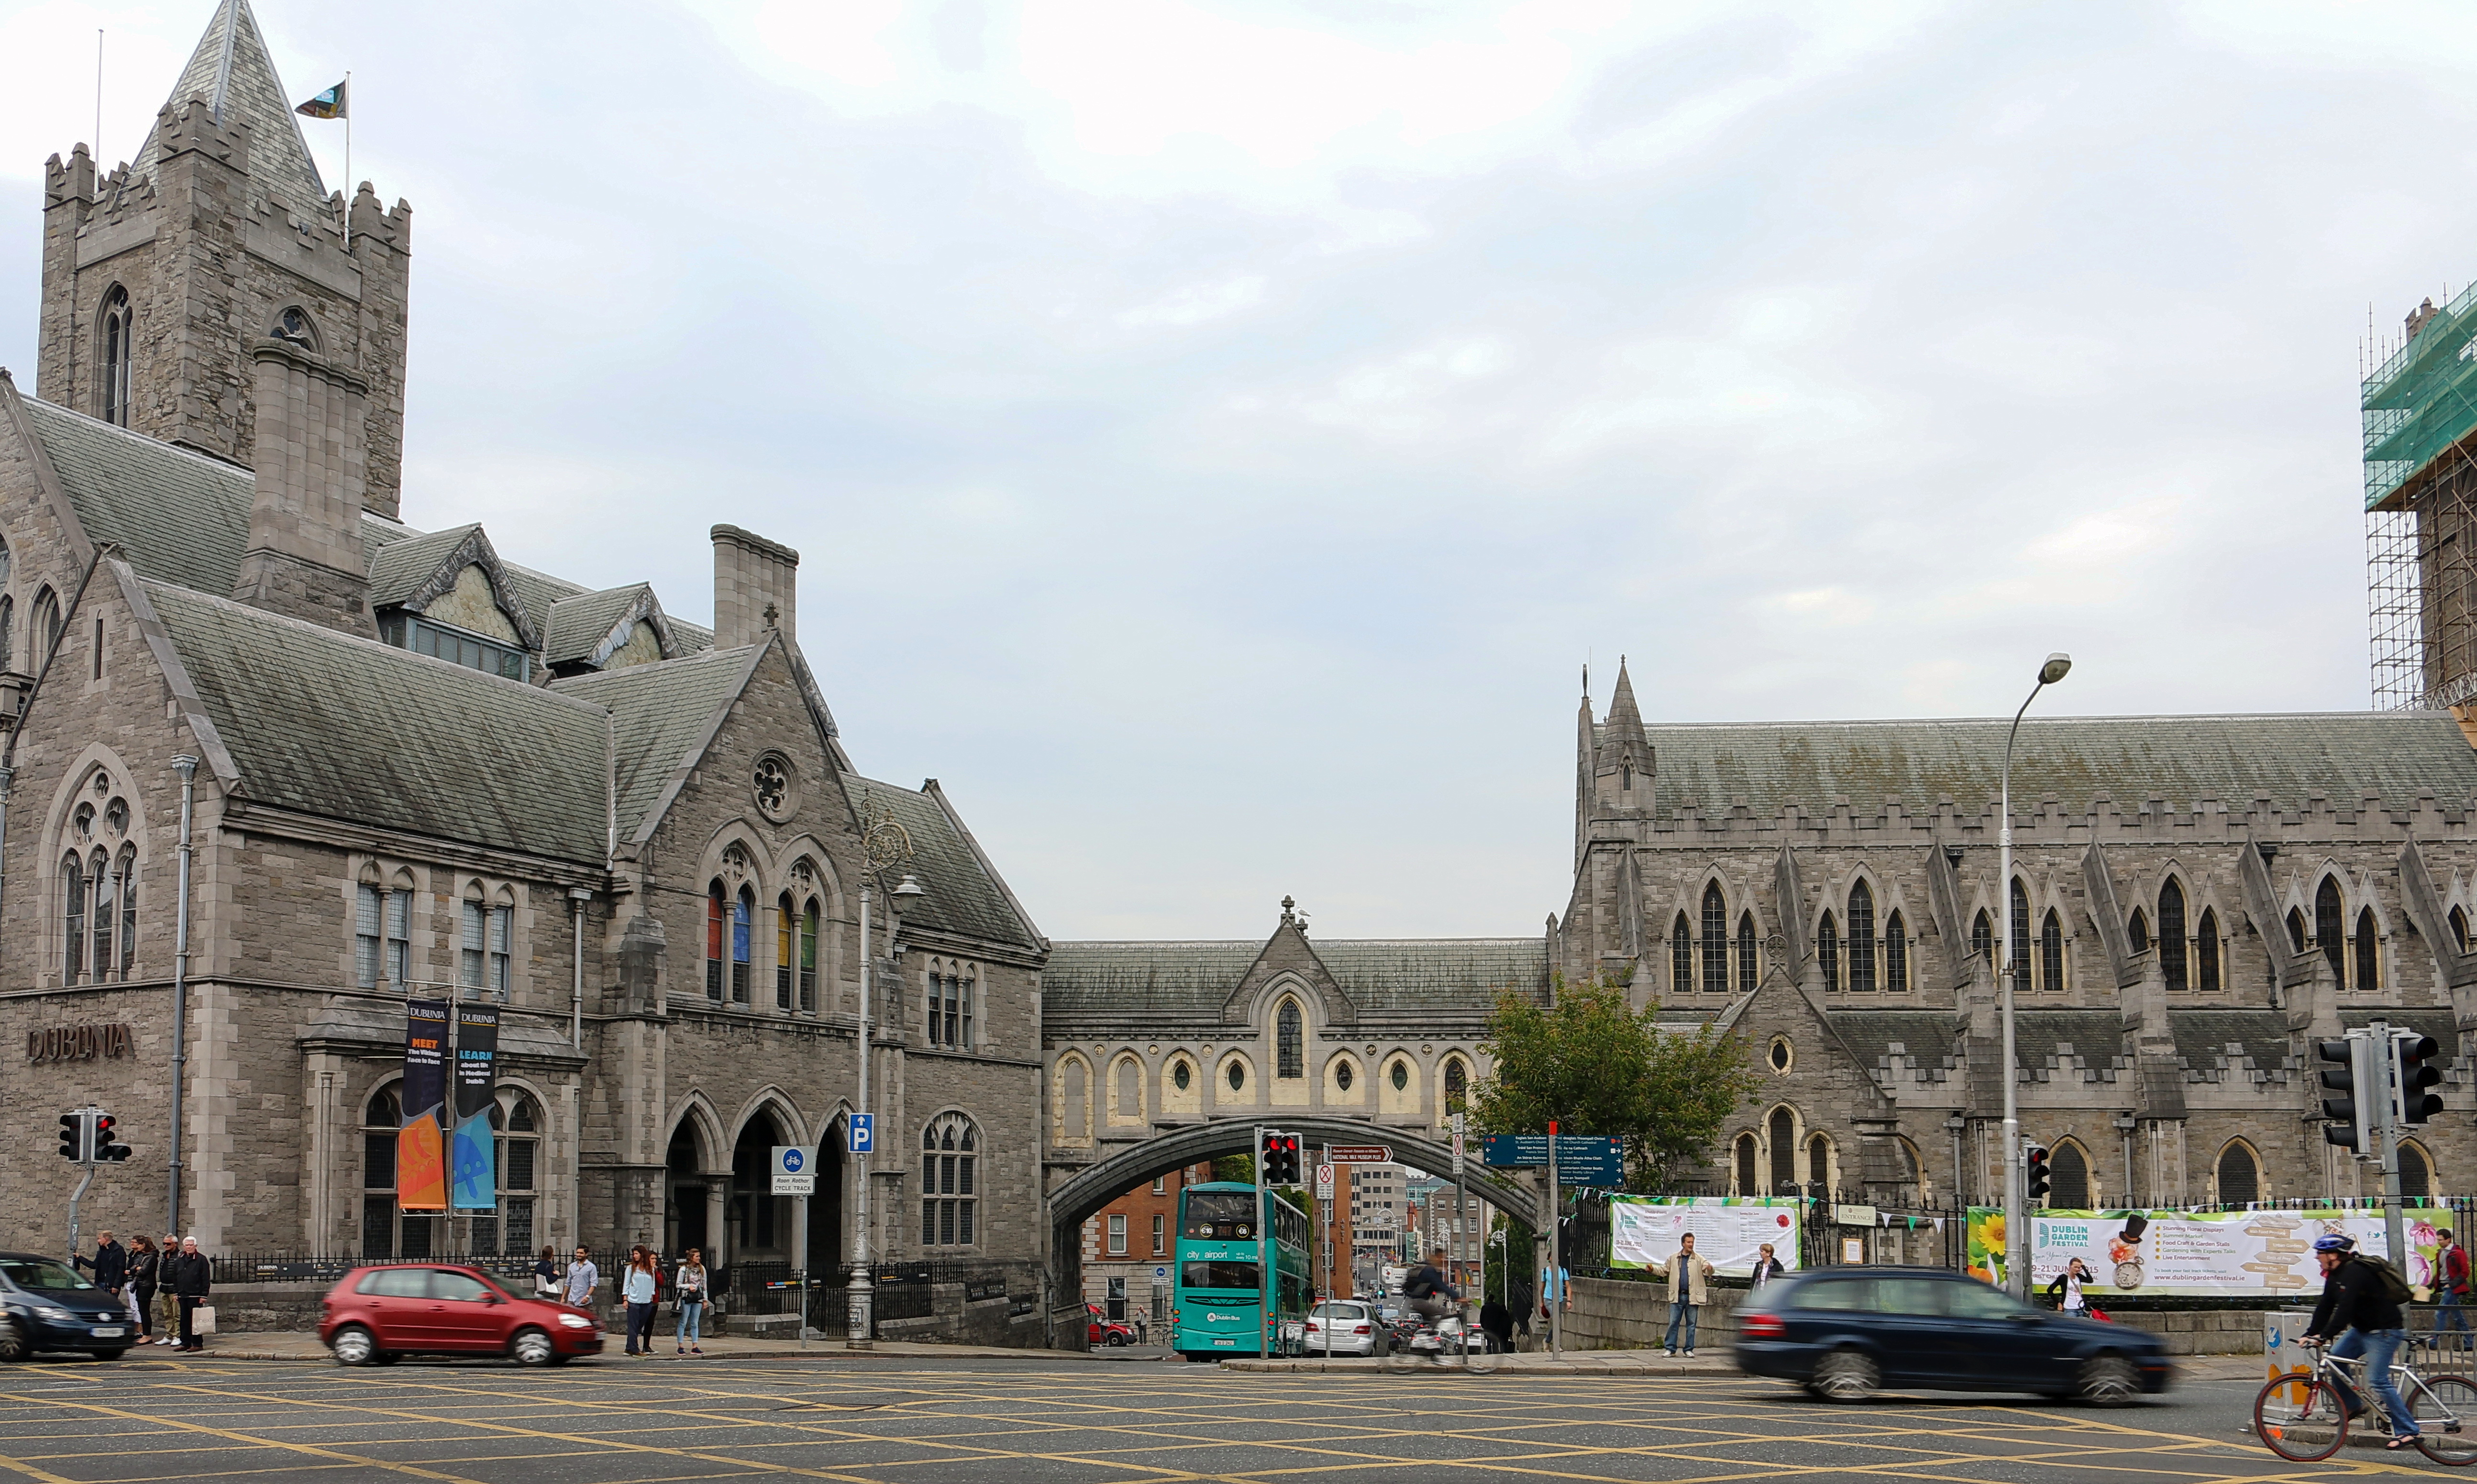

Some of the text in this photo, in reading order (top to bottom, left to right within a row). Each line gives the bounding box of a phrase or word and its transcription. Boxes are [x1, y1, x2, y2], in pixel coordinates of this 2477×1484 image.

[410, 1008, 445, 1019] DUBLINIA
[462, 1013, 496, 1023] DUBLINIA
[26, 1023, 136, 1061] DUBLINIA
[412, 1038, 438, 1049] MEET
[460, 1050, 492, 1060] LEARN
[854, 1128, 869, 1150] P
[1217, 1226, 1232, 1236] 747
[1187, 1251, 1227, 1260] city airport
